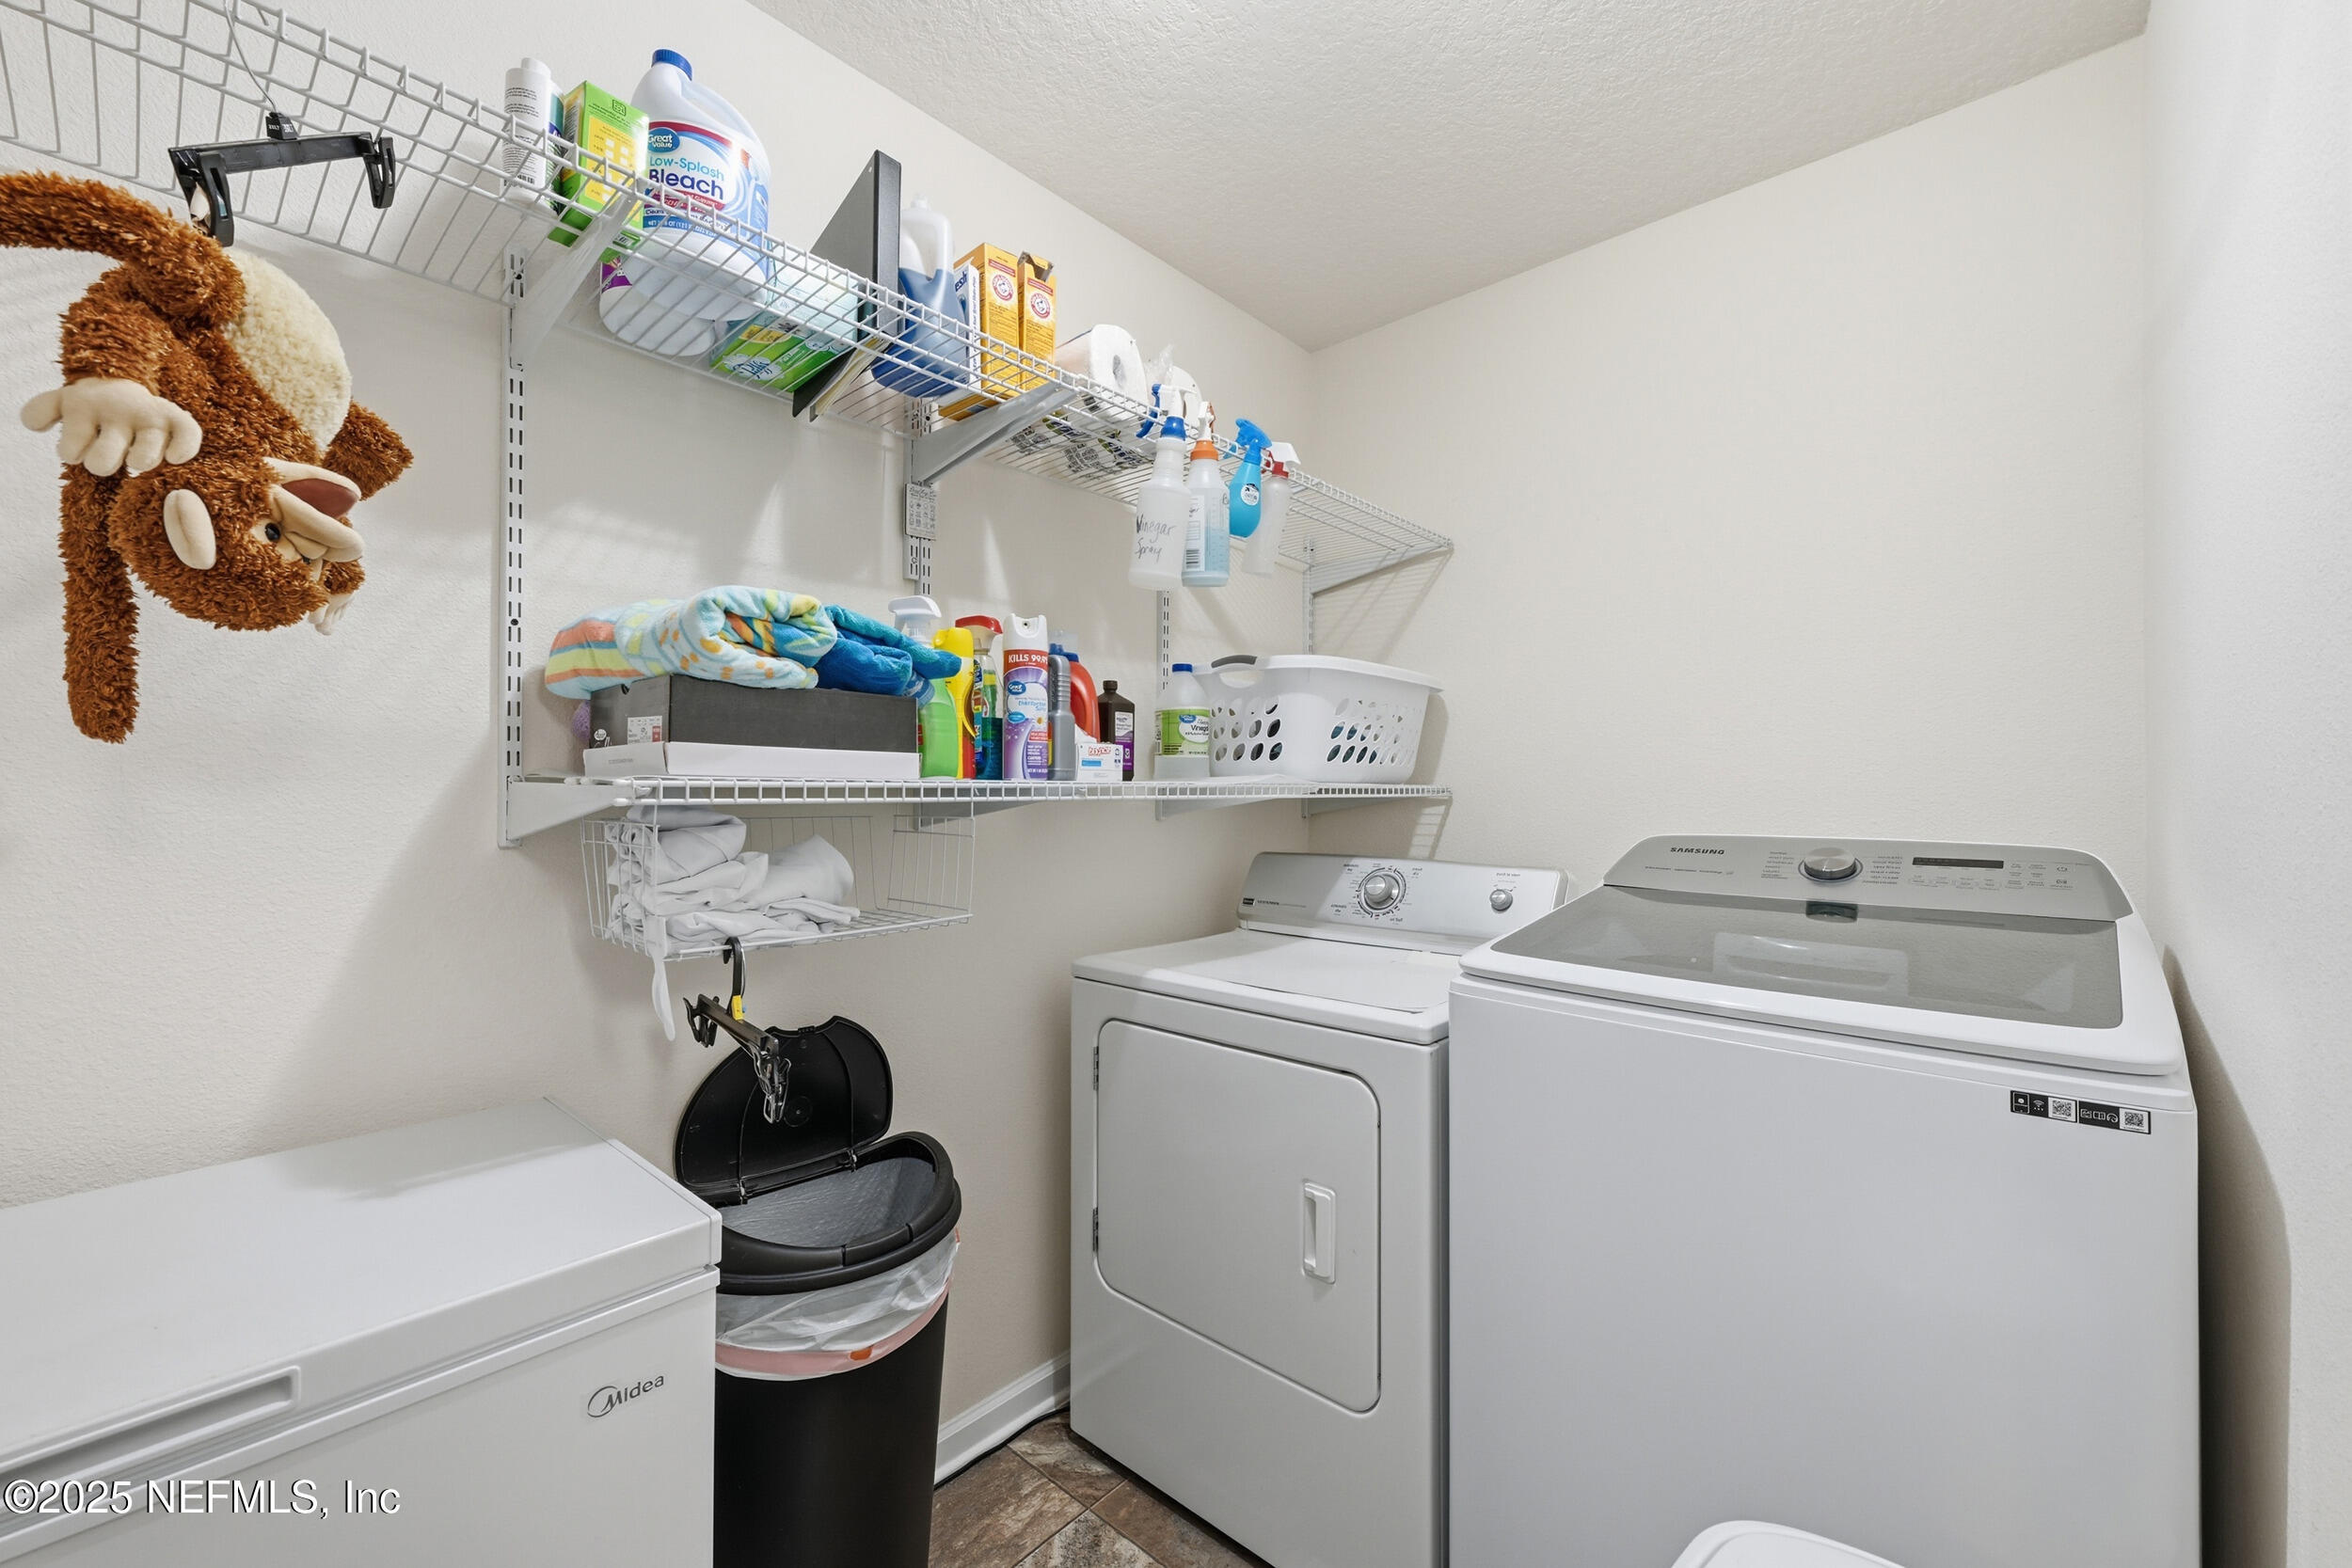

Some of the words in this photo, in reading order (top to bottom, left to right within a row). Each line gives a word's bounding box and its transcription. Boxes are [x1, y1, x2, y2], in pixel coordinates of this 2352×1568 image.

[649, 134, 673, 143] Great
[649, 156, 724, 181] Low-Splash
[648, 168, 723, 200] Bleach
[1136, 514, 1177, 544] Vinegar
[1135, 537, 1163, 562] Spray
[1008, 654, 1029, 664] KILLS
[1670, 847, 1725, 856] SAMSUNG
[587, 1375, 664, 1418] Midea
